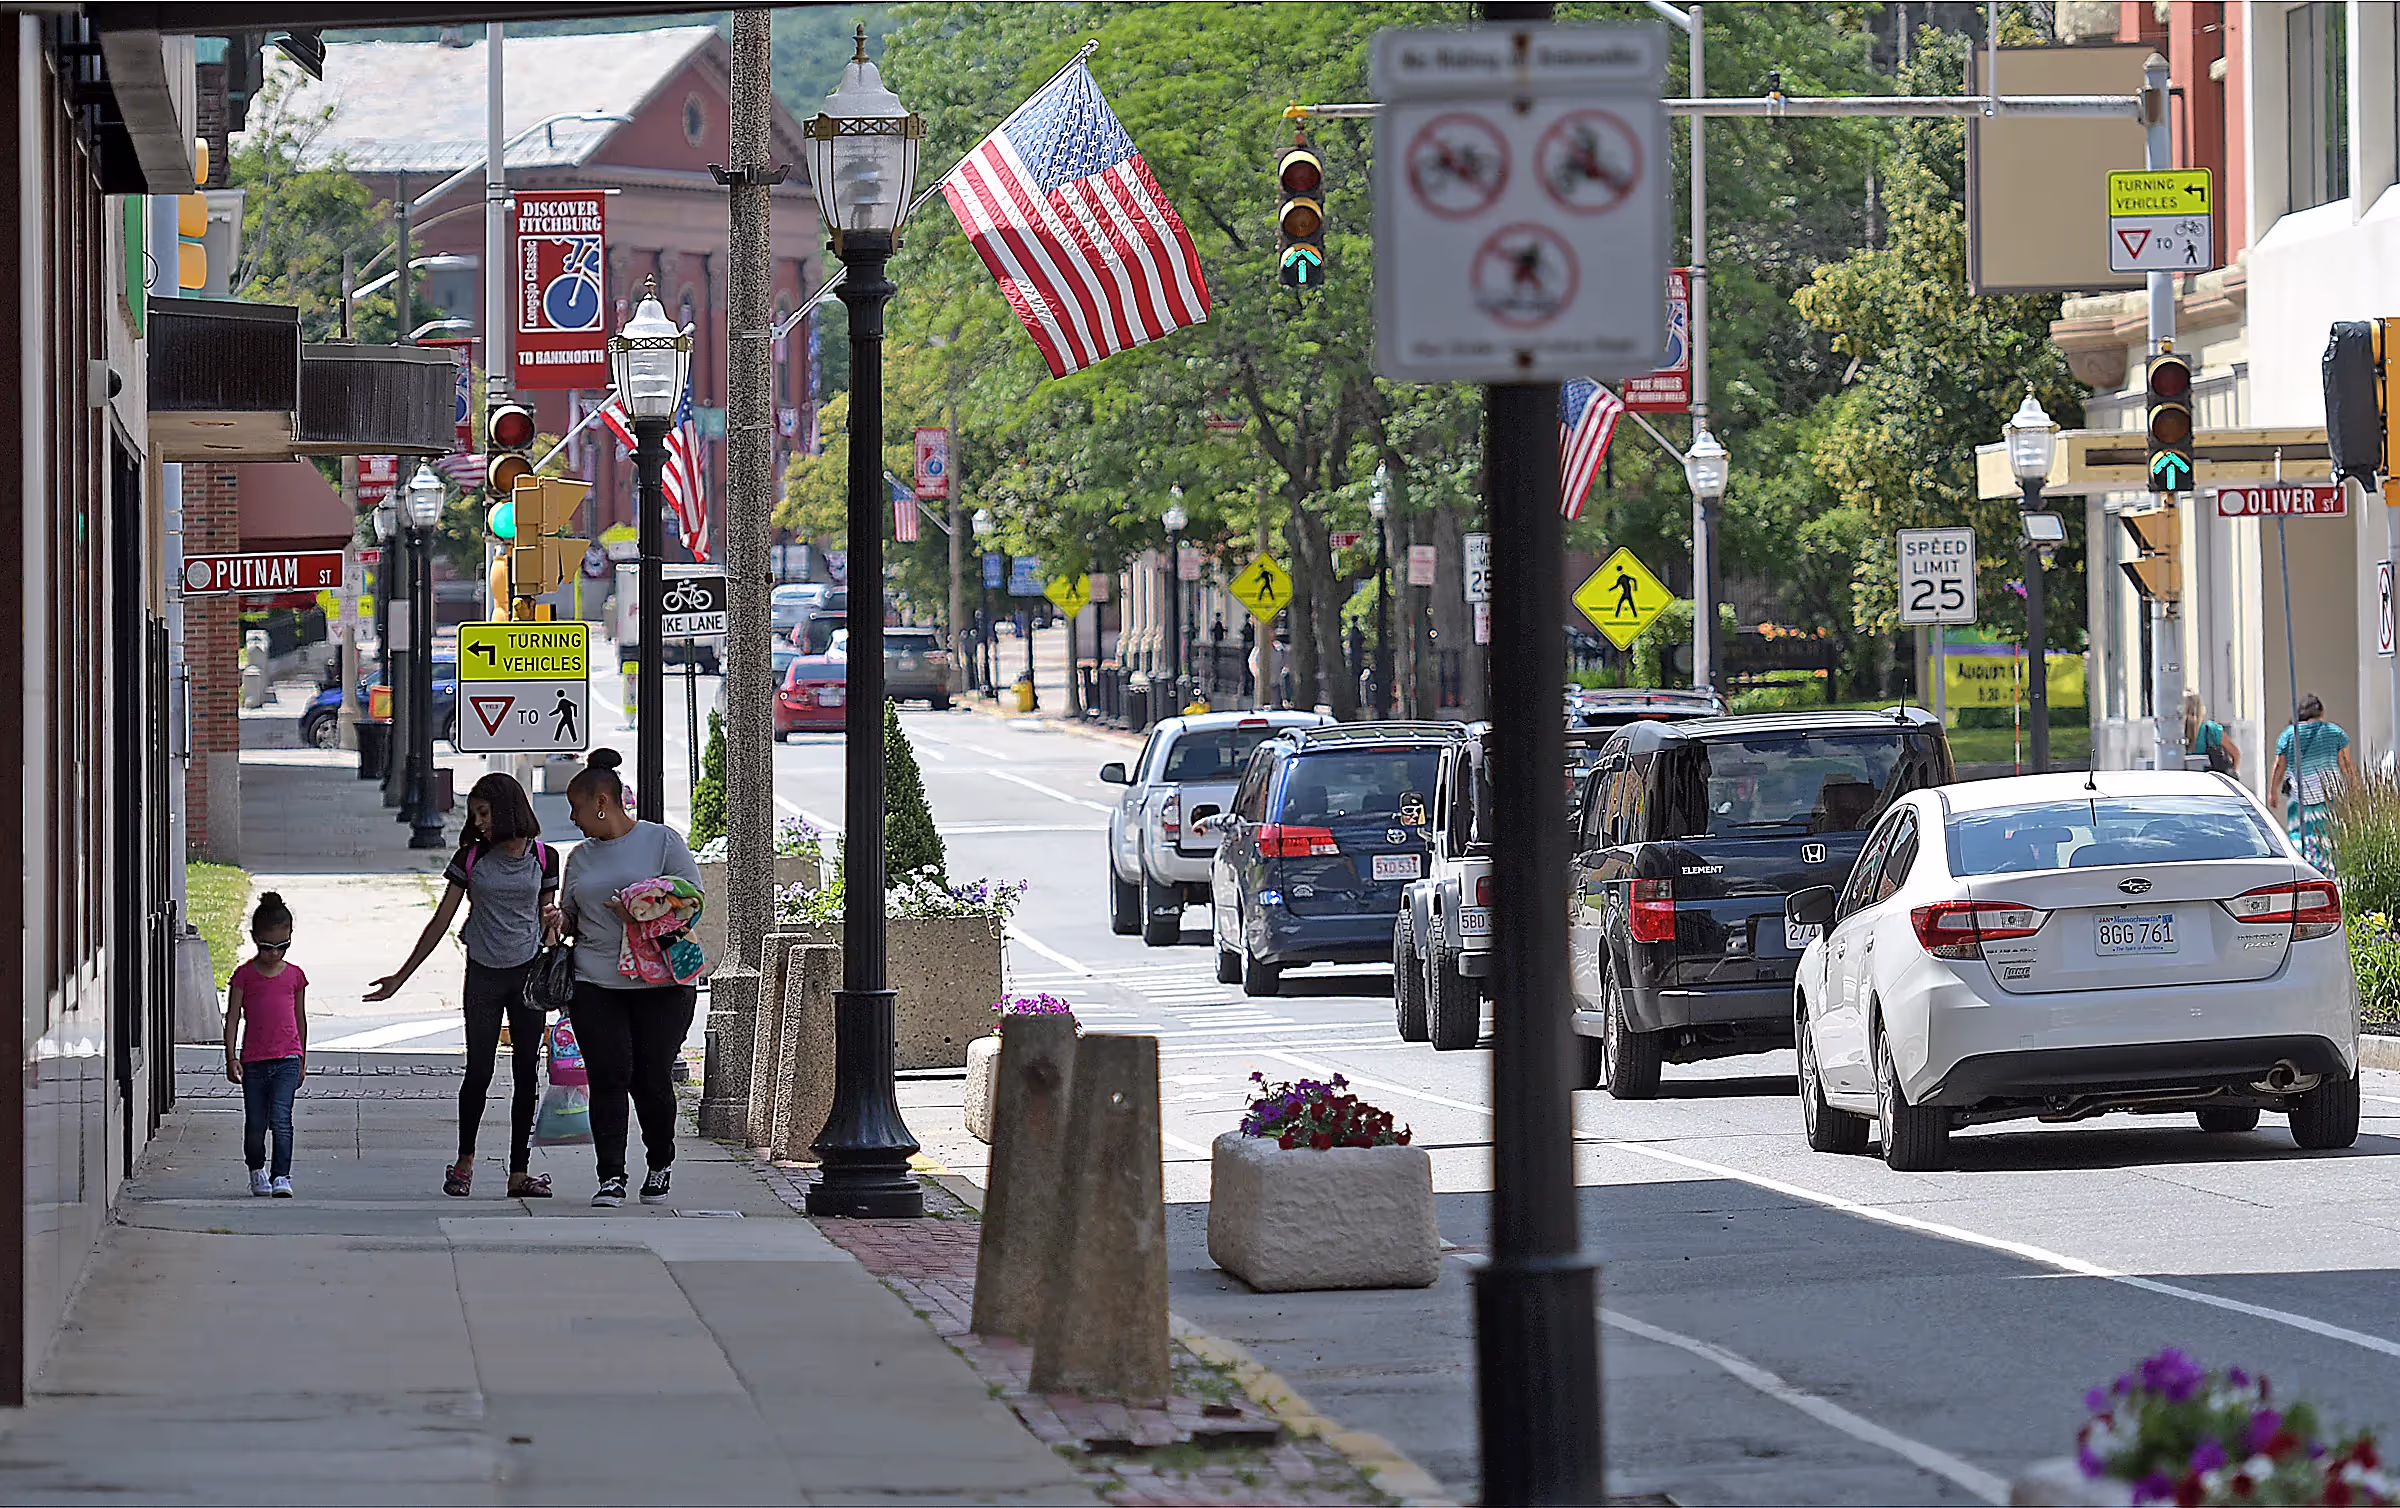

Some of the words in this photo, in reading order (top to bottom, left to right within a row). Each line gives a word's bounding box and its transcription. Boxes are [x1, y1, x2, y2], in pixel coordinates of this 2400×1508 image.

[2116, 179, 2174, 192] TURNING
[522, 201, 599, 217] DISCOVER
[2116, 196, 2178, 209] VEHICLES
[518, 216, 602, 232] FITCHBURG
[2156, 237, 2173, 249] TO
[524, 240, 537, 281] Classic
[524, 282, 539, 327] Longsjo
[518, 351, 534, 365] TD
[535, 349, 604, 364] BANKNORTH
[2247, 489, 2315, 514] OLIVER
[2323, 498, 2335, 512] ST
[1906, 541, 1967, 556] SPEED
[216, 558, 298, 587] PUTNAM
[319, 569, 331, 584] ST
[1913, 560, 1960, 574] LIMIT
[1911, 580, 1964, 611] 25
[662, 617, 683, 633] IKE
[688, 615, 723, 631] LANE
[508, 633, 581, 648] TURNING
[503, 656, 581, 671] VEHICLES
[517, 709, 539, 725] TO
[1682, 865, 1724, 875] ELEMENT
[2100, 924, 2134, 945] 8GG
[2139, 923, 2174, 943] 761
